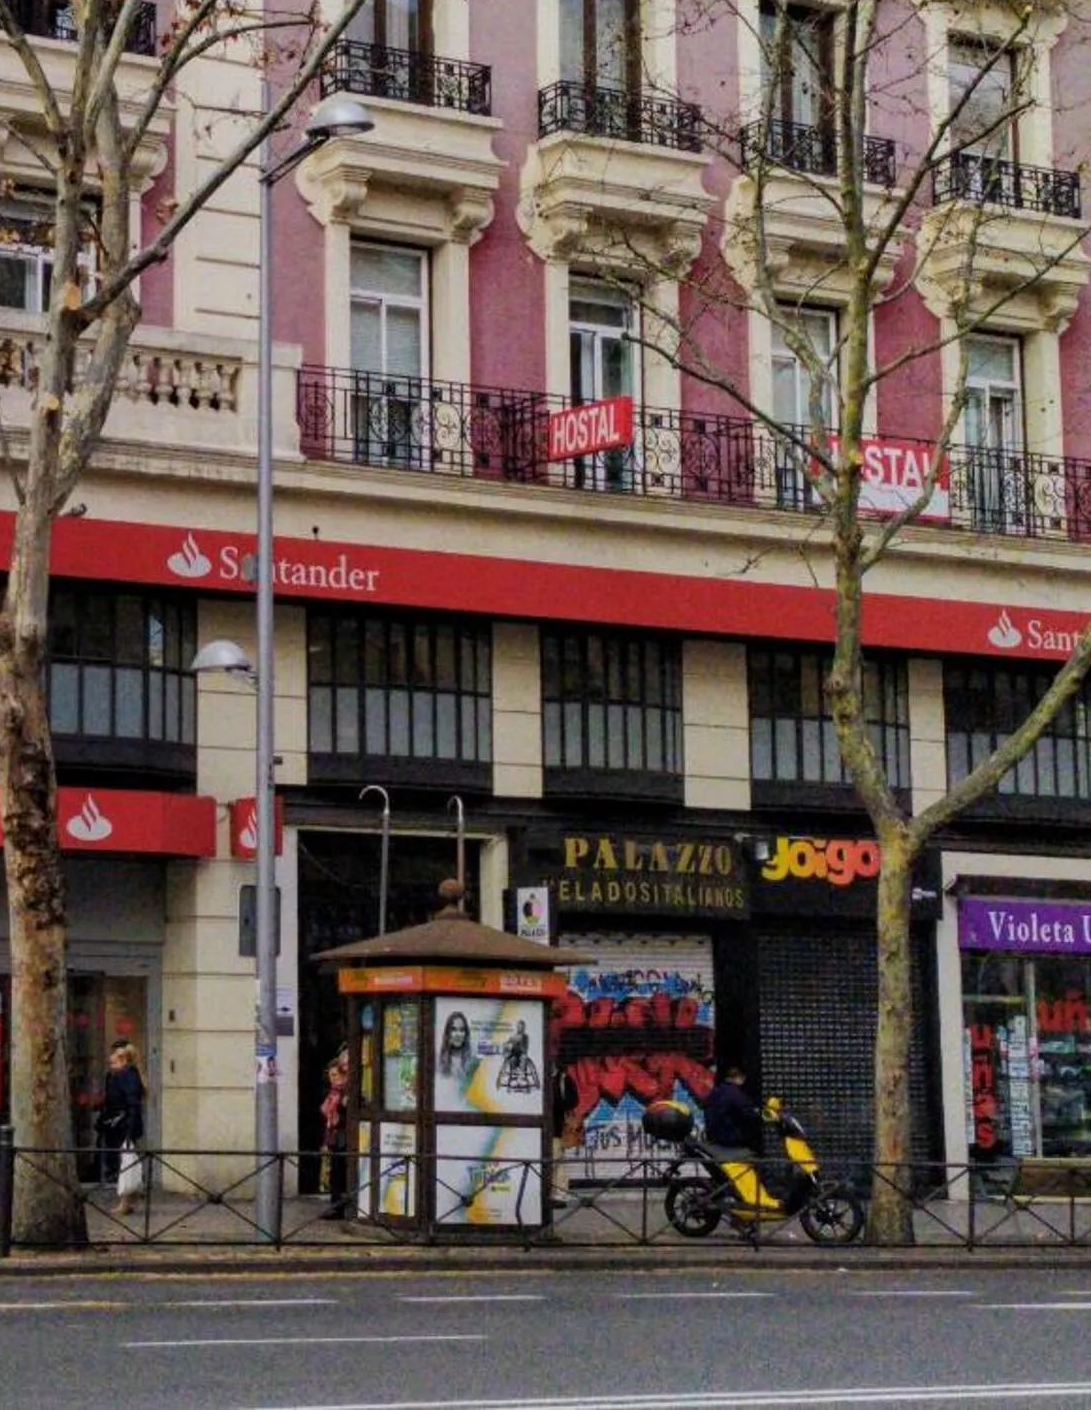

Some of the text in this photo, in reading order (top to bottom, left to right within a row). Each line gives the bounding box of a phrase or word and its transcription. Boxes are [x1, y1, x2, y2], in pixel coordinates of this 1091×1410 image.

[553, 403, 620, 454] HOSTAL
[219, 546, 379, 591] Stander
[563, 837, 734, 875] PALAZZO
[988, 911, 1075, 943] Violeta
